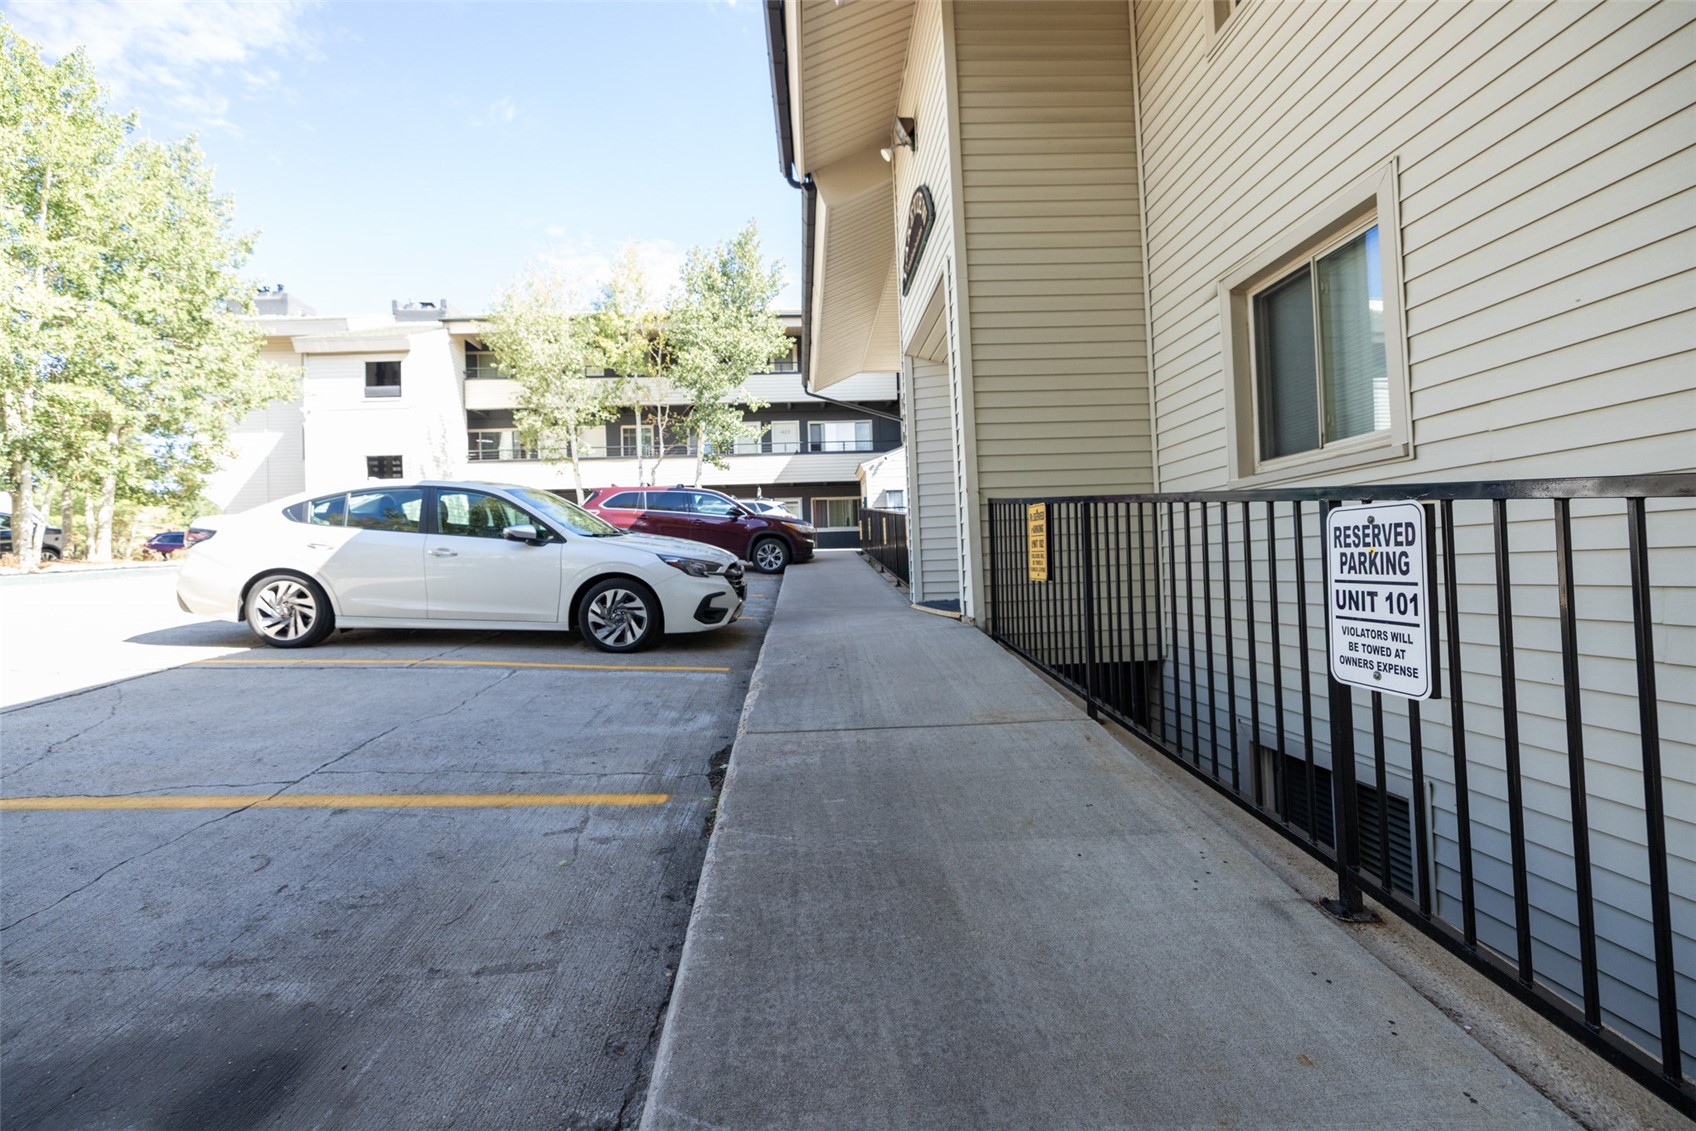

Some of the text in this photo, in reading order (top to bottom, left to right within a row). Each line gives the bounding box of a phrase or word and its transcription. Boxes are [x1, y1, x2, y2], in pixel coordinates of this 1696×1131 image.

[1333, 522, 1416, 548] RESERVED
[1340, 551, 1410, 576] PARKING
[1335, 589, 1418, 616] UNIT 101
[1341, 626, 1414, 644] VIOLATORS WILL
[1348, 642, 1406, 660] BE TOWED AT
[1339, 655, 1419, 679] OWNERS EXPENSE
